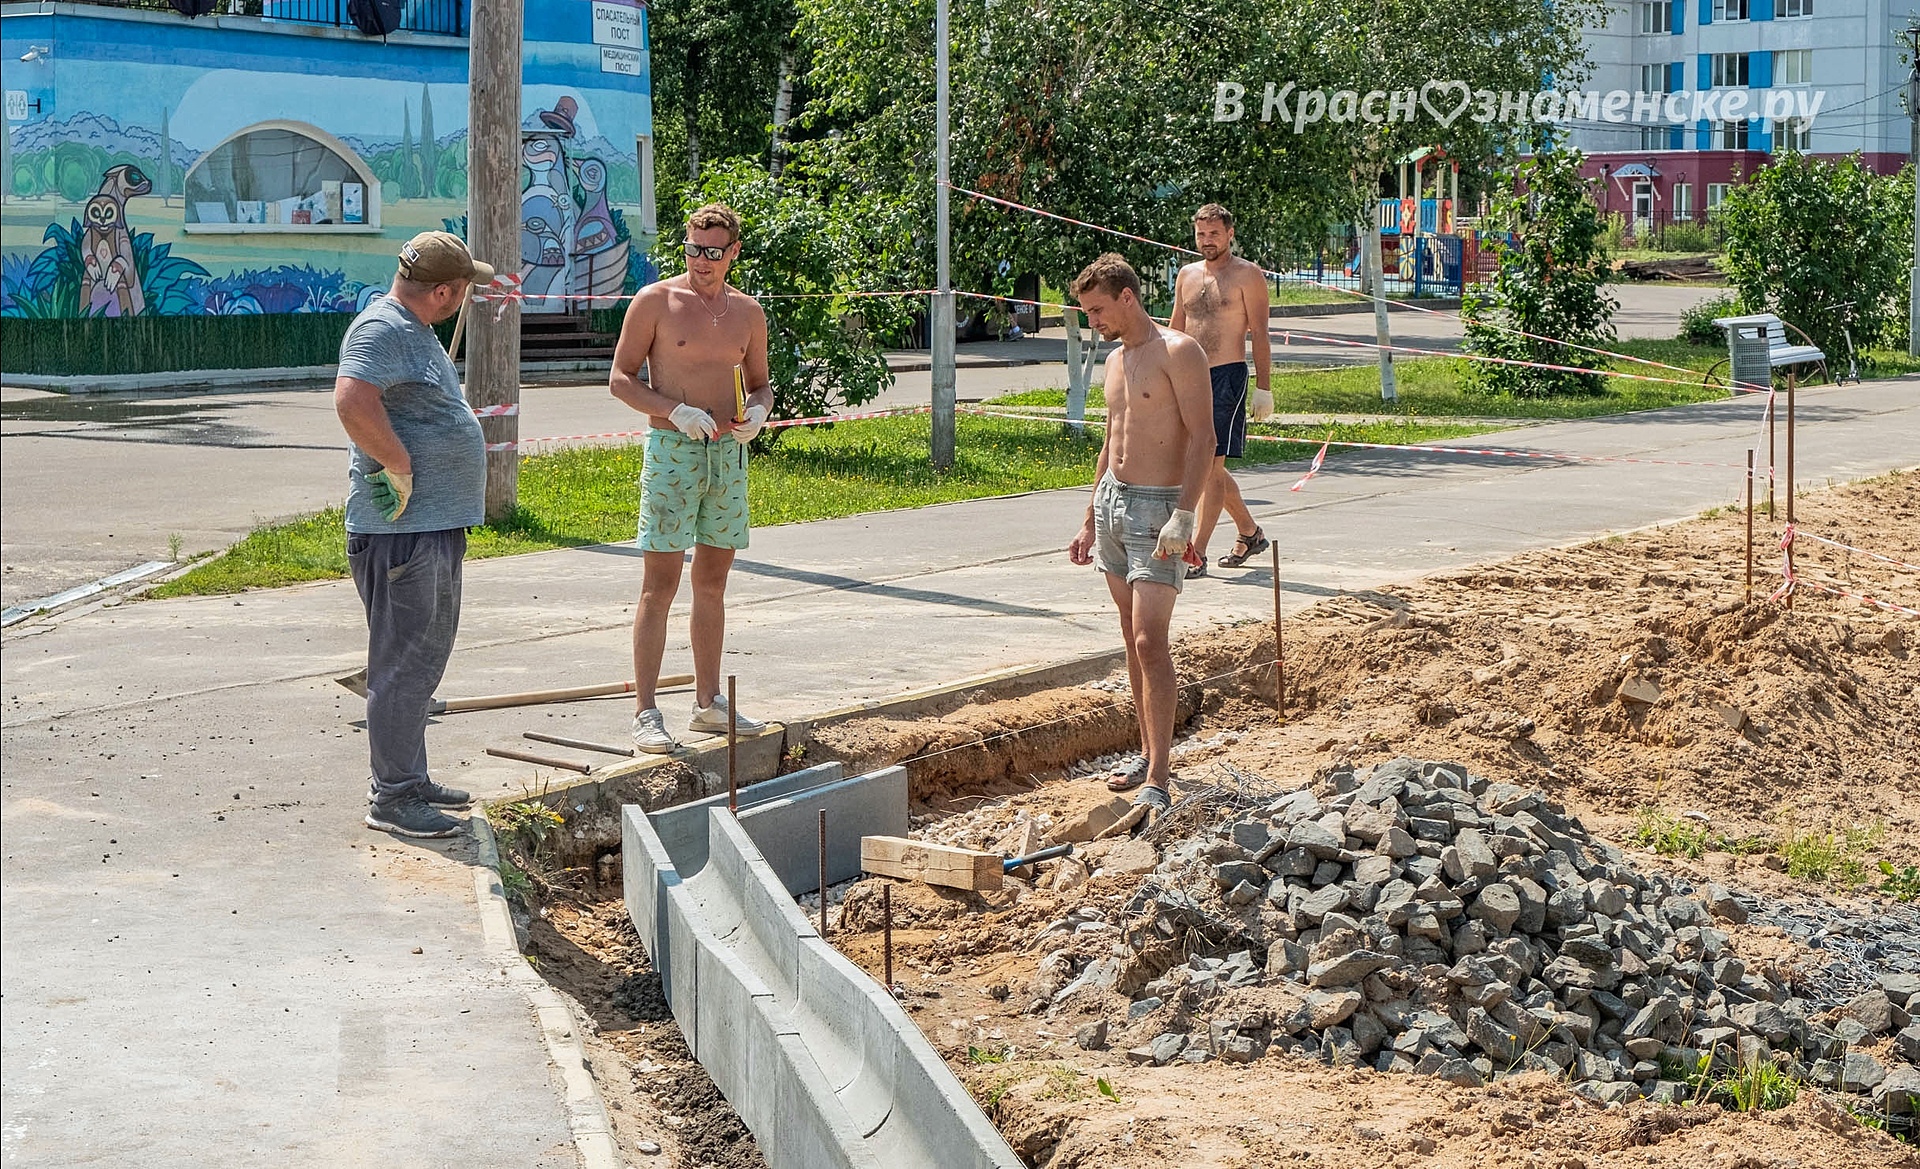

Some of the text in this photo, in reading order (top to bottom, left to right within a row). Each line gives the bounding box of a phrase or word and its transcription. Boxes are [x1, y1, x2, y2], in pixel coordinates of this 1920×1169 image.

[595, 8, 640, 26] СПАСАТЕЛЬНЫЙ
[611, 26, 630, 40] ПОСТ
[603, 49, 639, 62] МЕДИЦИНСКИЙ
[615, 62, 631, 72] ПОСТ
